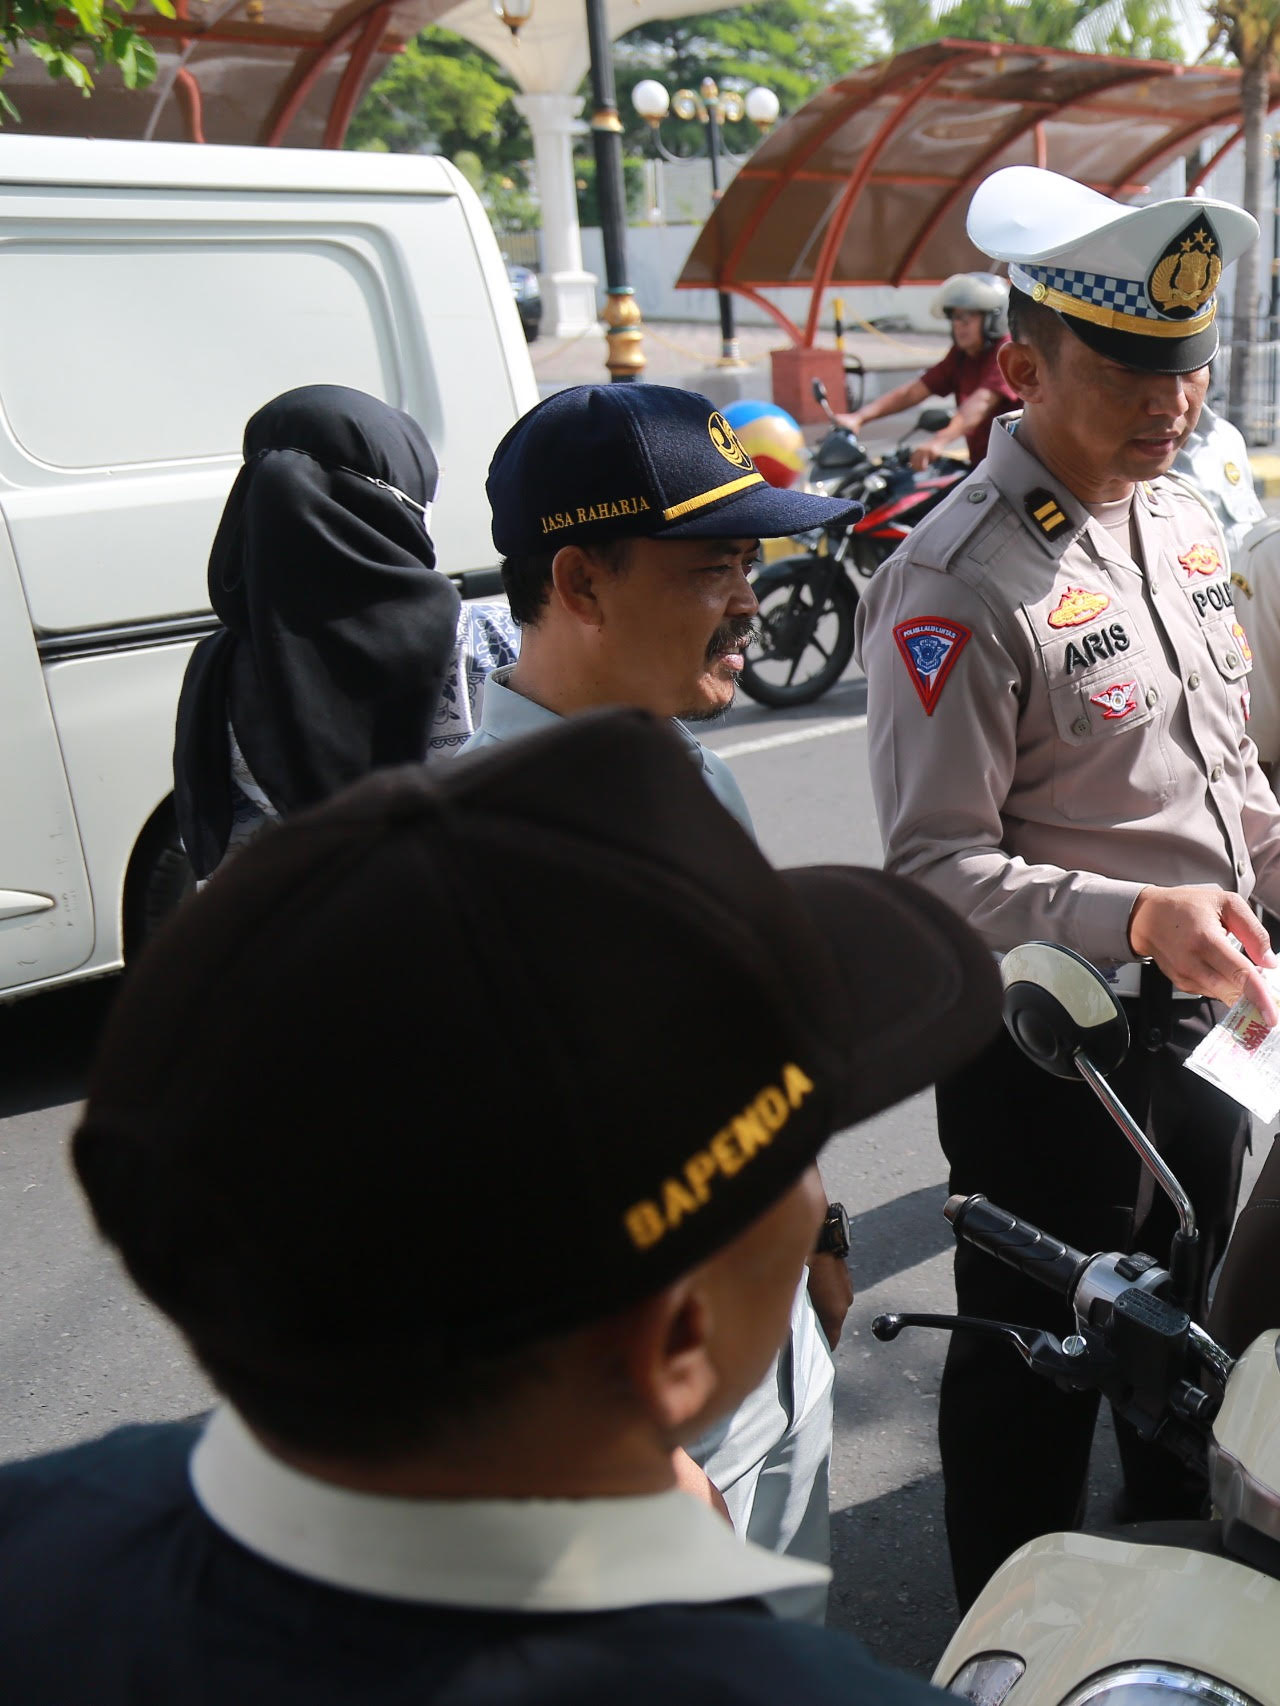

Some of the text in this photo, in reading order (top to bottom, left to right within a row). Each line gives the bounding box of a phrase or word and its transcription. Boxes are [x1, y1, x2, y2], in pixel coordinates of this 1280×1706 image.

[541, 496, 651, 534] JASA RAHARJA
[1064, 622, 1131, 675] ARIS
[624, 1061, 814, 1250] BAPENDA
